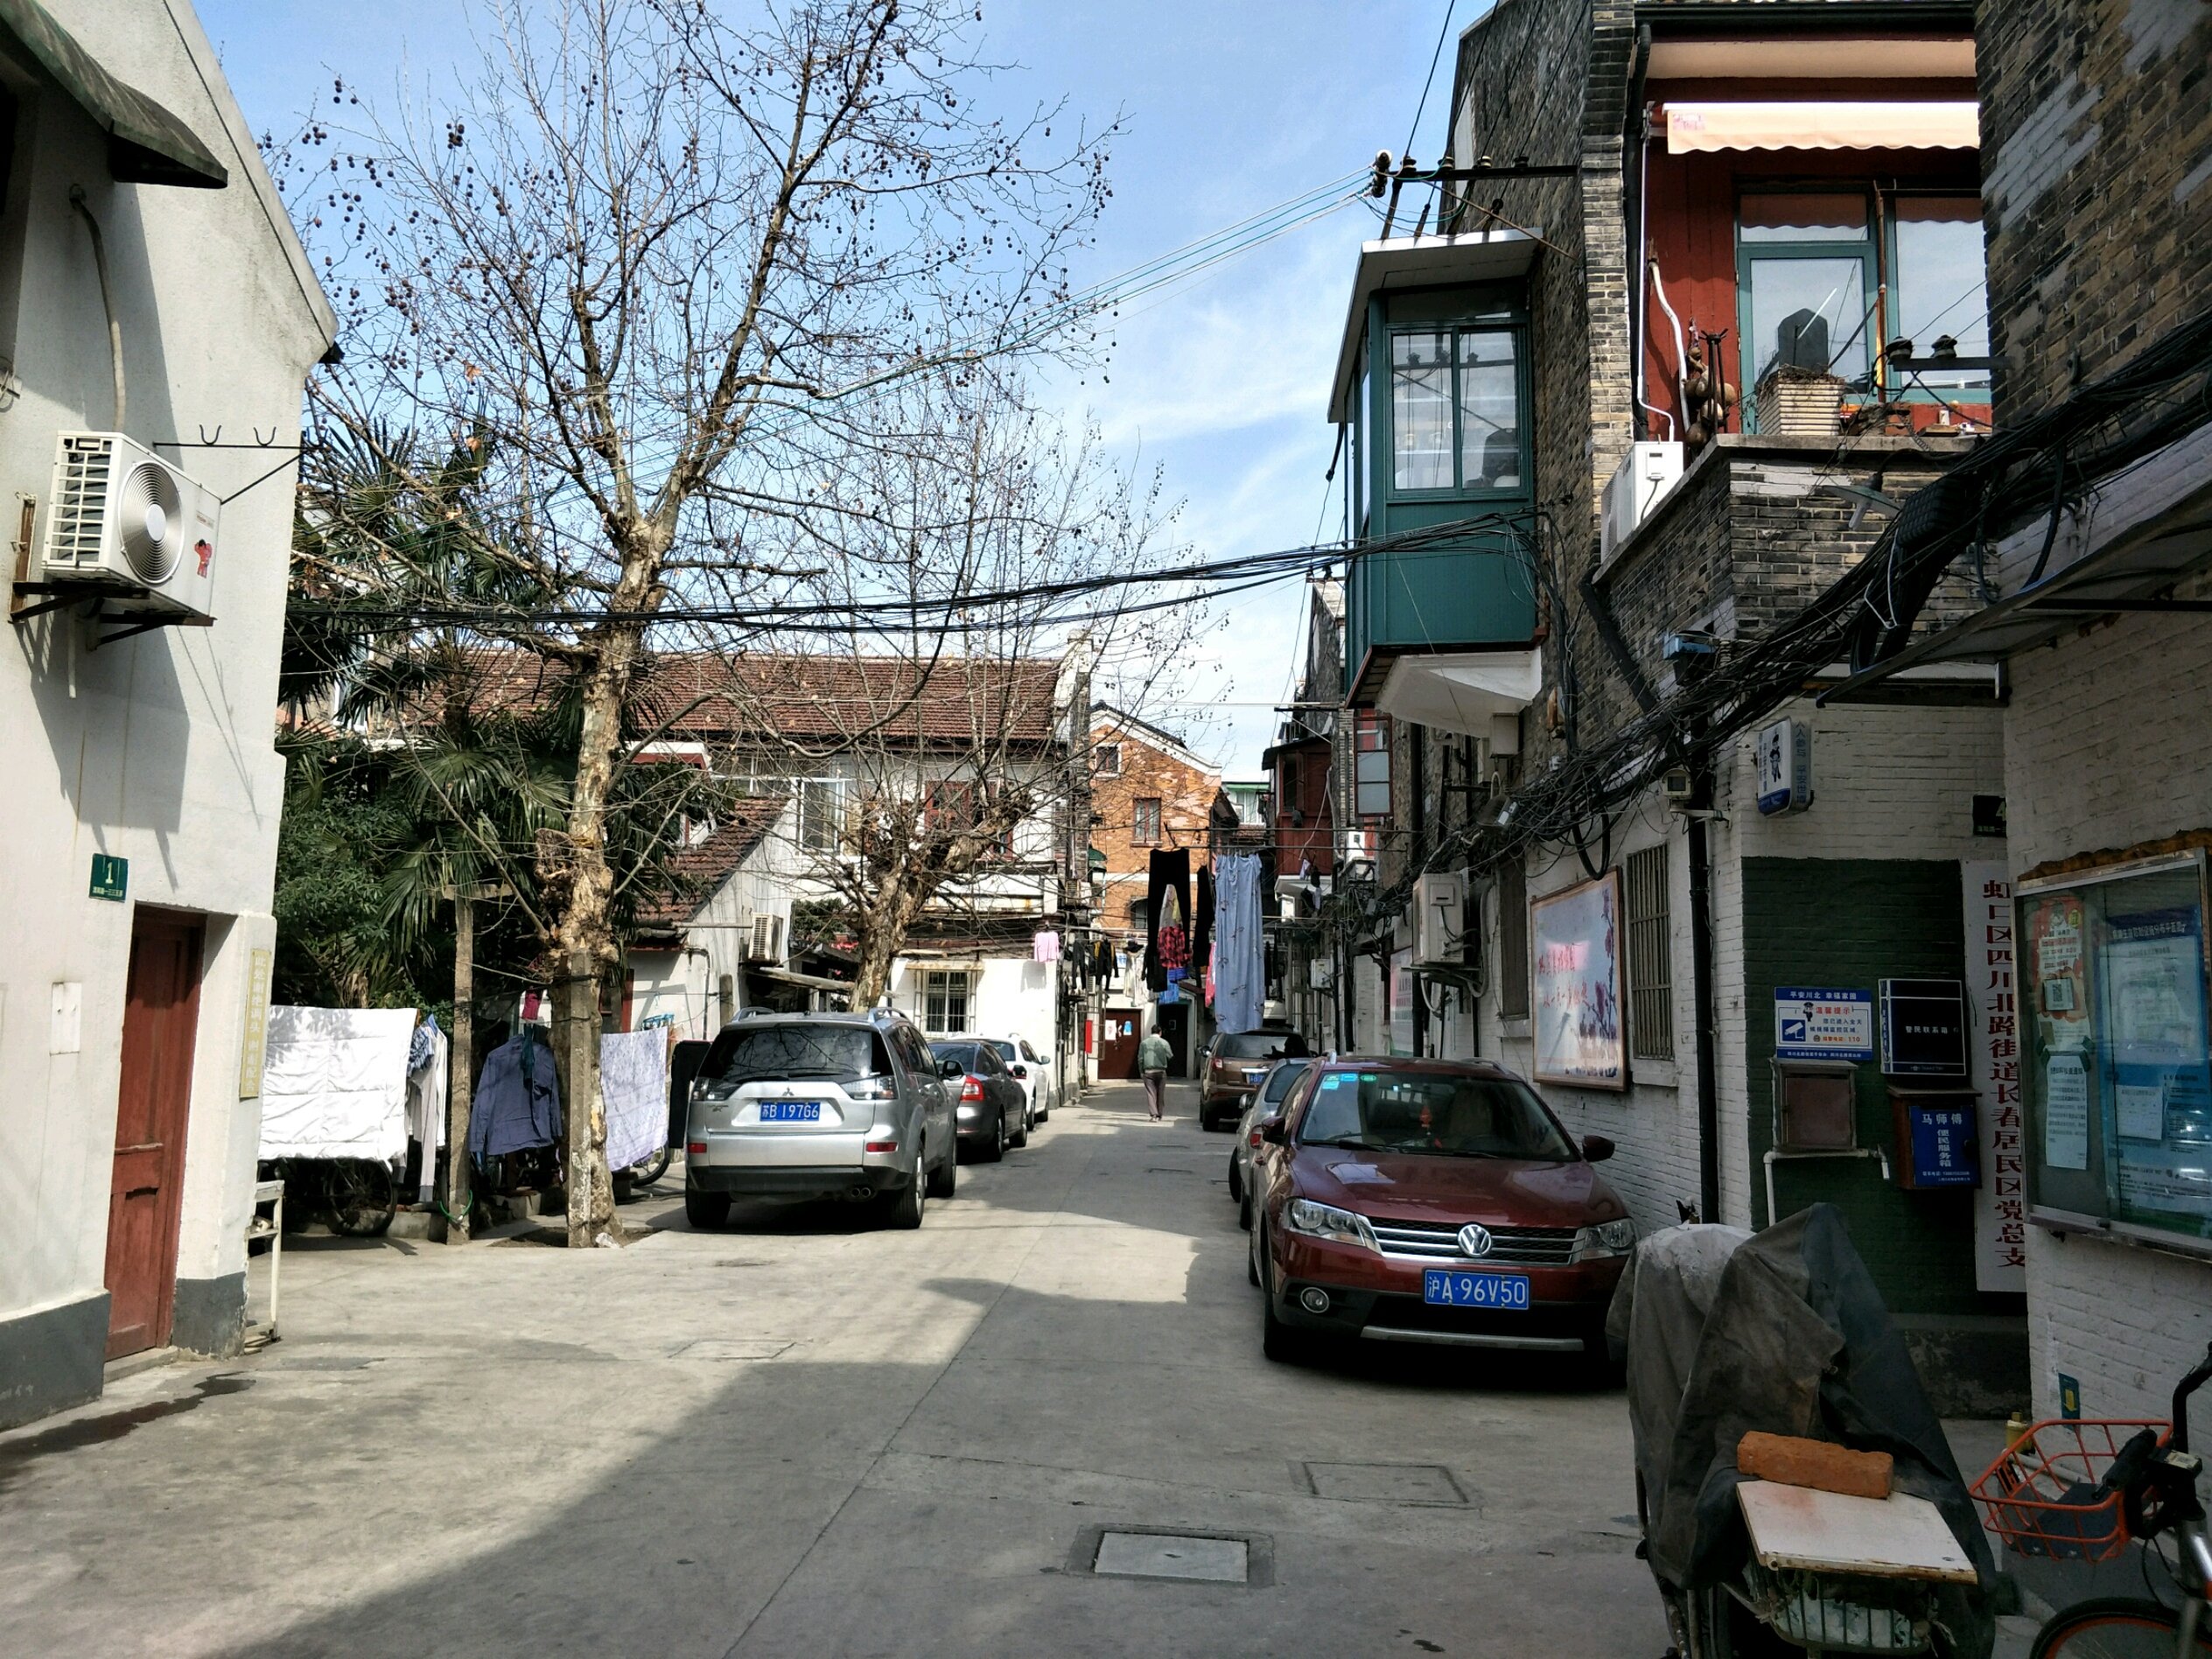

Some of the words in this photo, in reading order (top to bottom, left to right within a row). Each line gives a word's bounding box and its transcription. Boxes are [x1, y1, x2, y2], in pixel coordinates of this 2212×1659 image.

[105, 862, 113, 884] 1
[1922, 1113, 1962, 1125] 马师傅
[1937, 1130, 1951, 1167] 便民服务箱
